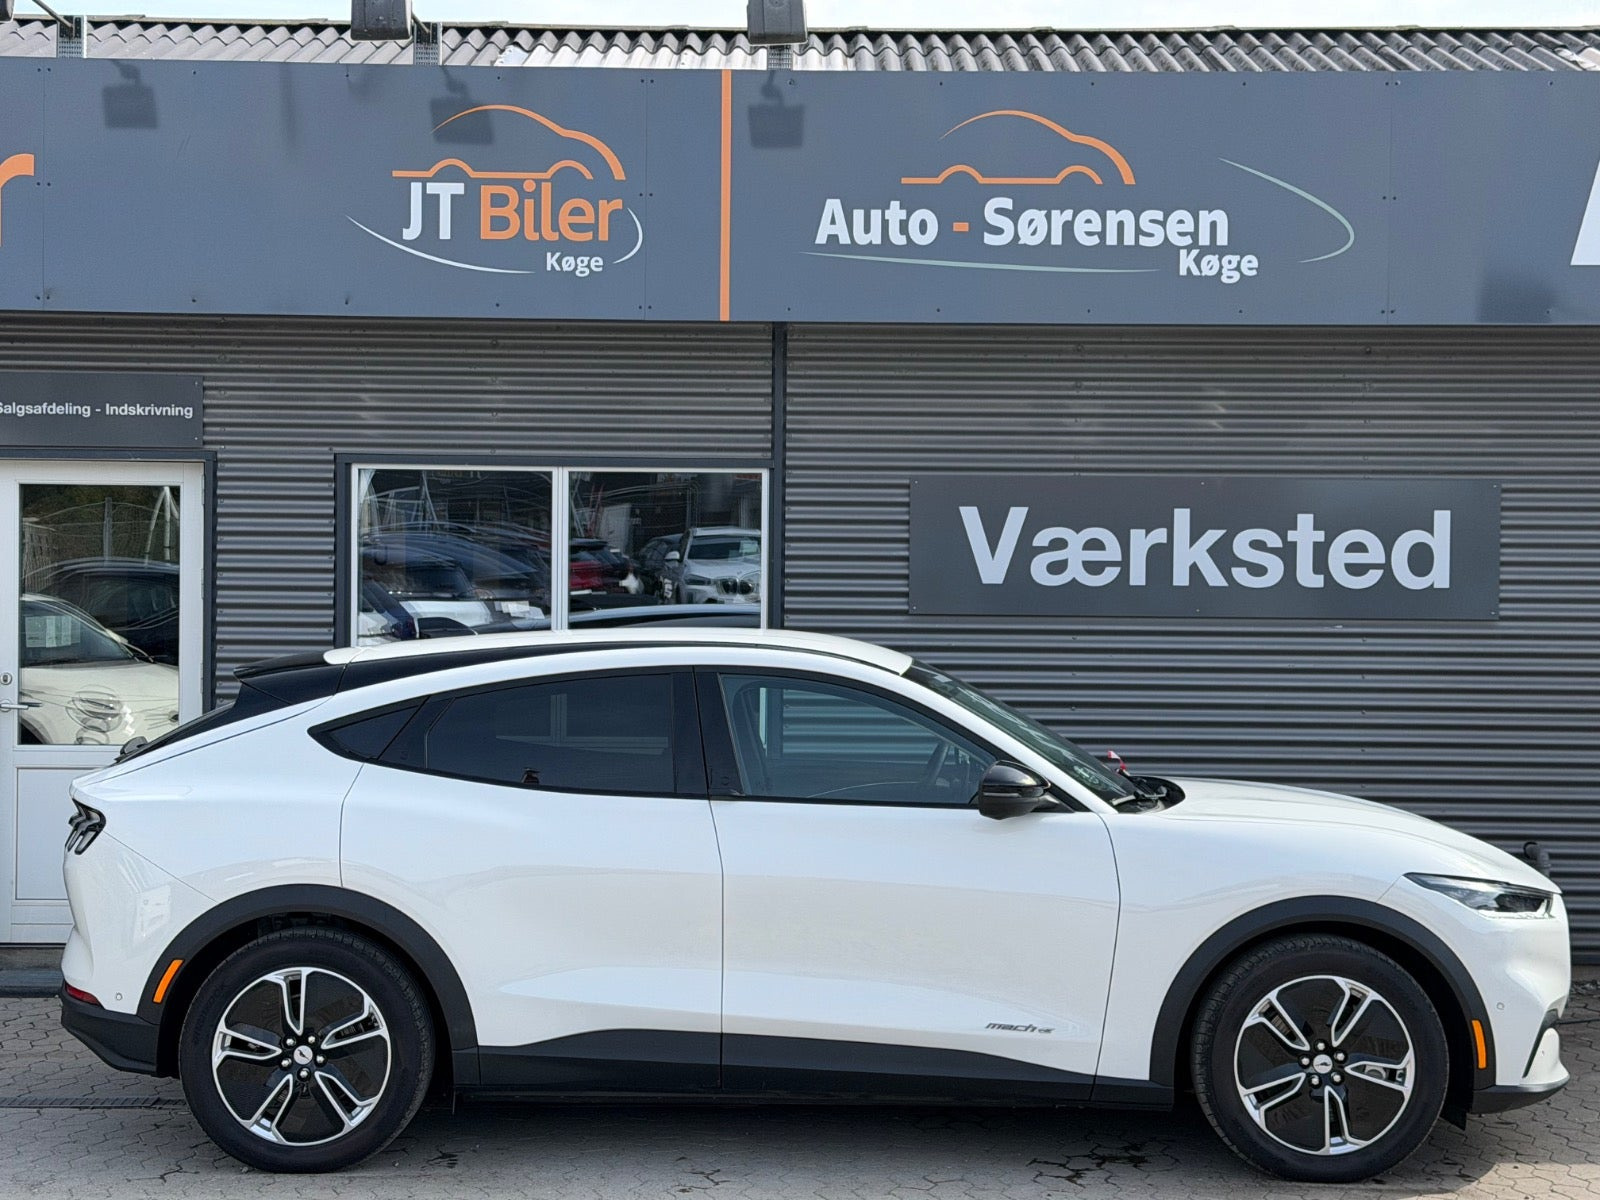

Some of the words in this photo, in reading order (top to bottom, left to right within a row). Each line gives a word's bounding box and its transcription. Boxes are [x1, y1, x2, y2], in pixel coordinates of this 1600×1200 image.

[402, 181, 465, 240] JT
[480, 179, 623, 242] Biler
[814, 198, 939, 246] Auto
[983, 196, 1229, 247] Sørensen
[546, 251, 604, 278] Køge
[1179, 248, 1259, 284] Køge
[105, 403, 194, 419] Indskrivning
[959, 506, 1451, 590] Værksted
